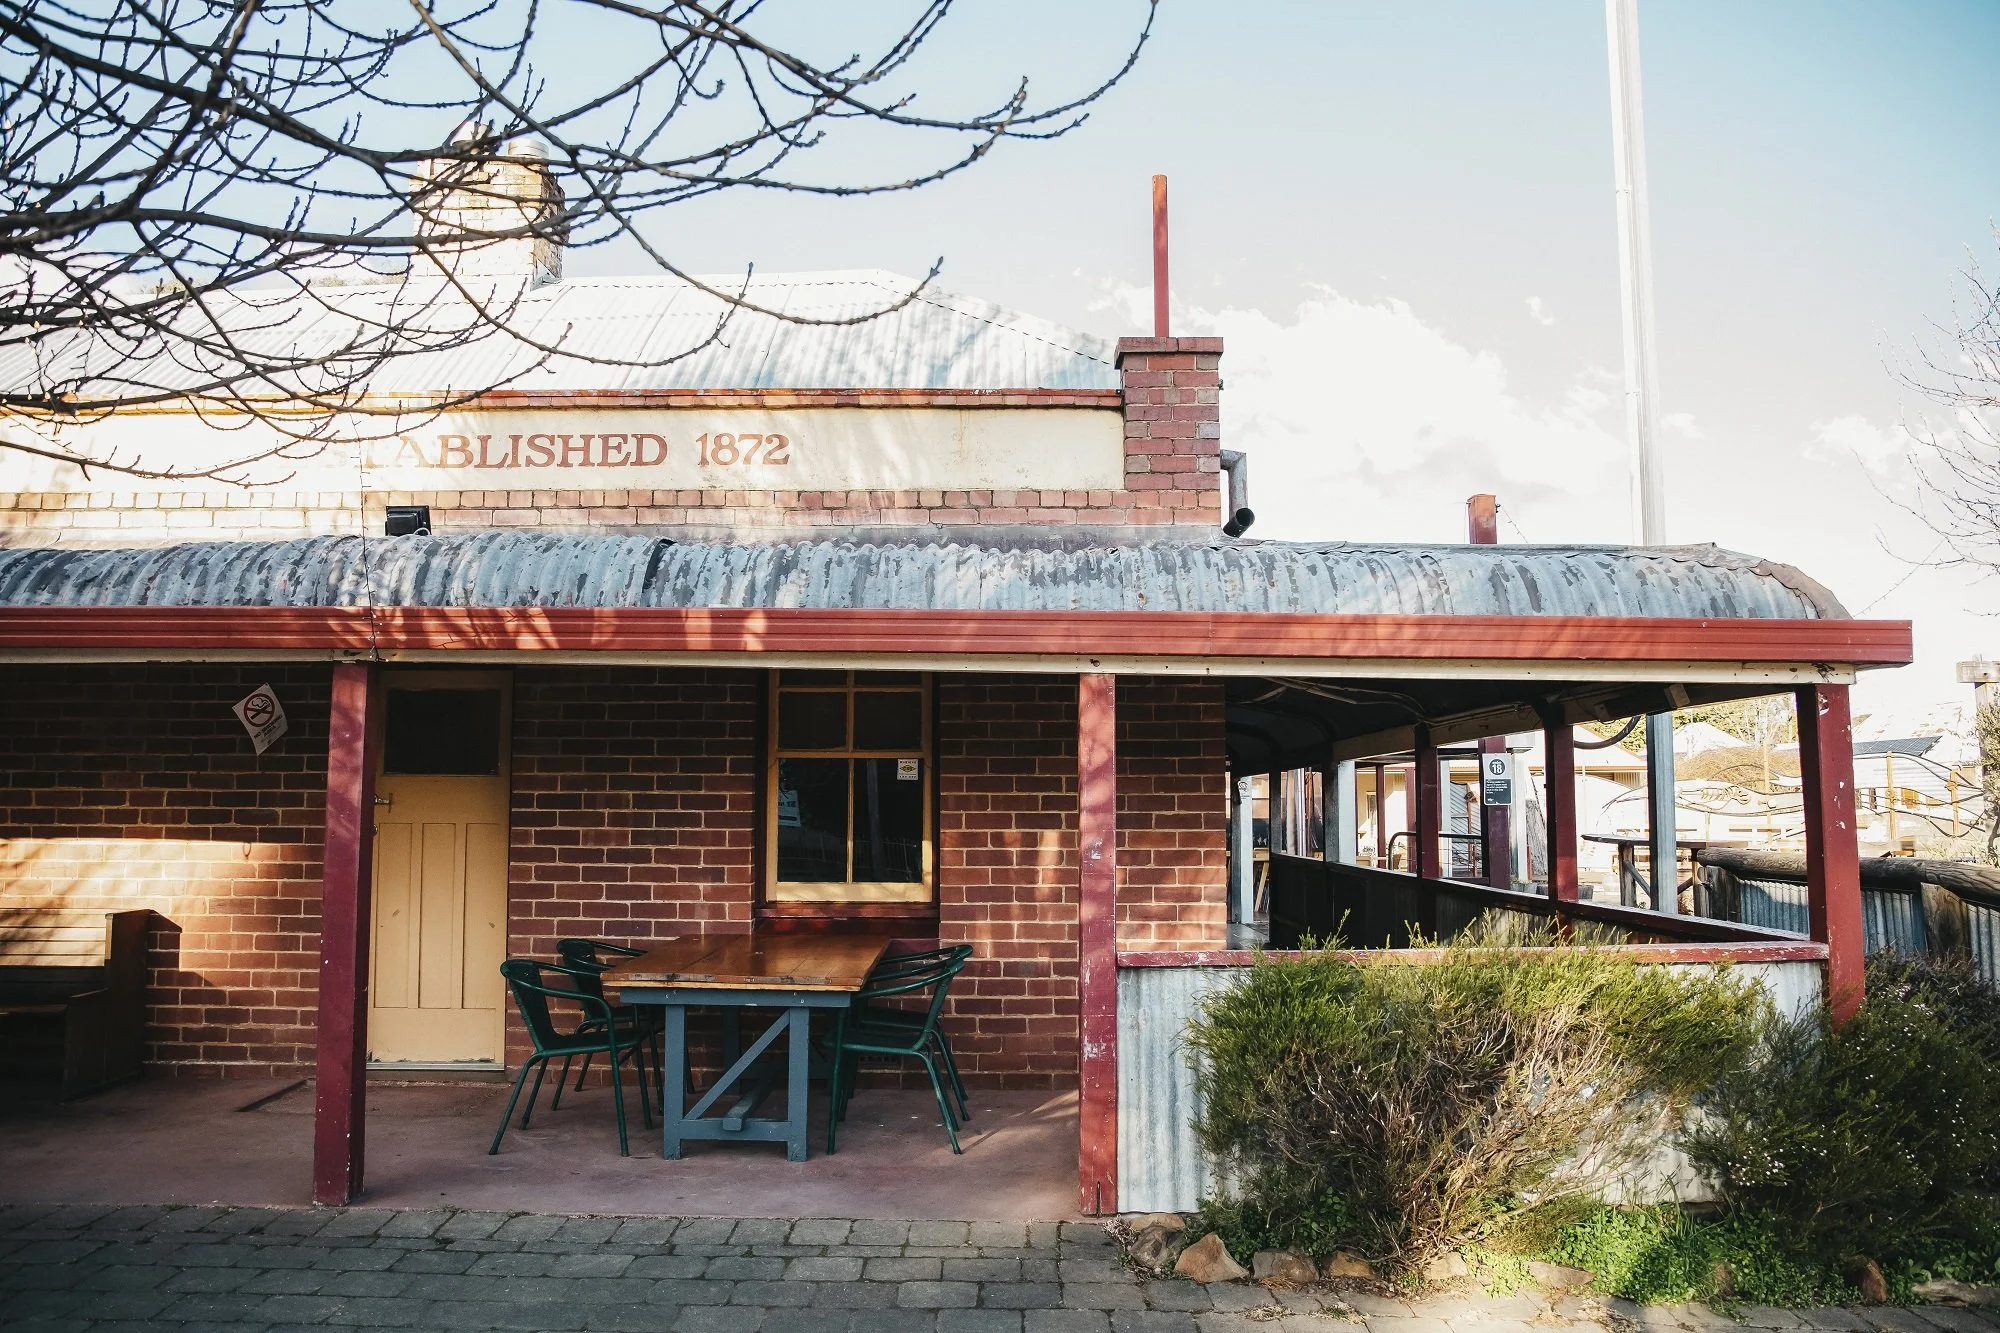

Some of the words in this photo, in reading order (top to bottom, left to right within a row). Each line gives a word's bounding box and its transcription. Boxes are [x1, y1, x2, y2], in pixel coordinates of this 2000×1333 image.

[328, 433, 668, 467] ABLISHED
[695, 432, 790, 466] 1872
[1492, 764, 1502, 774] 18
